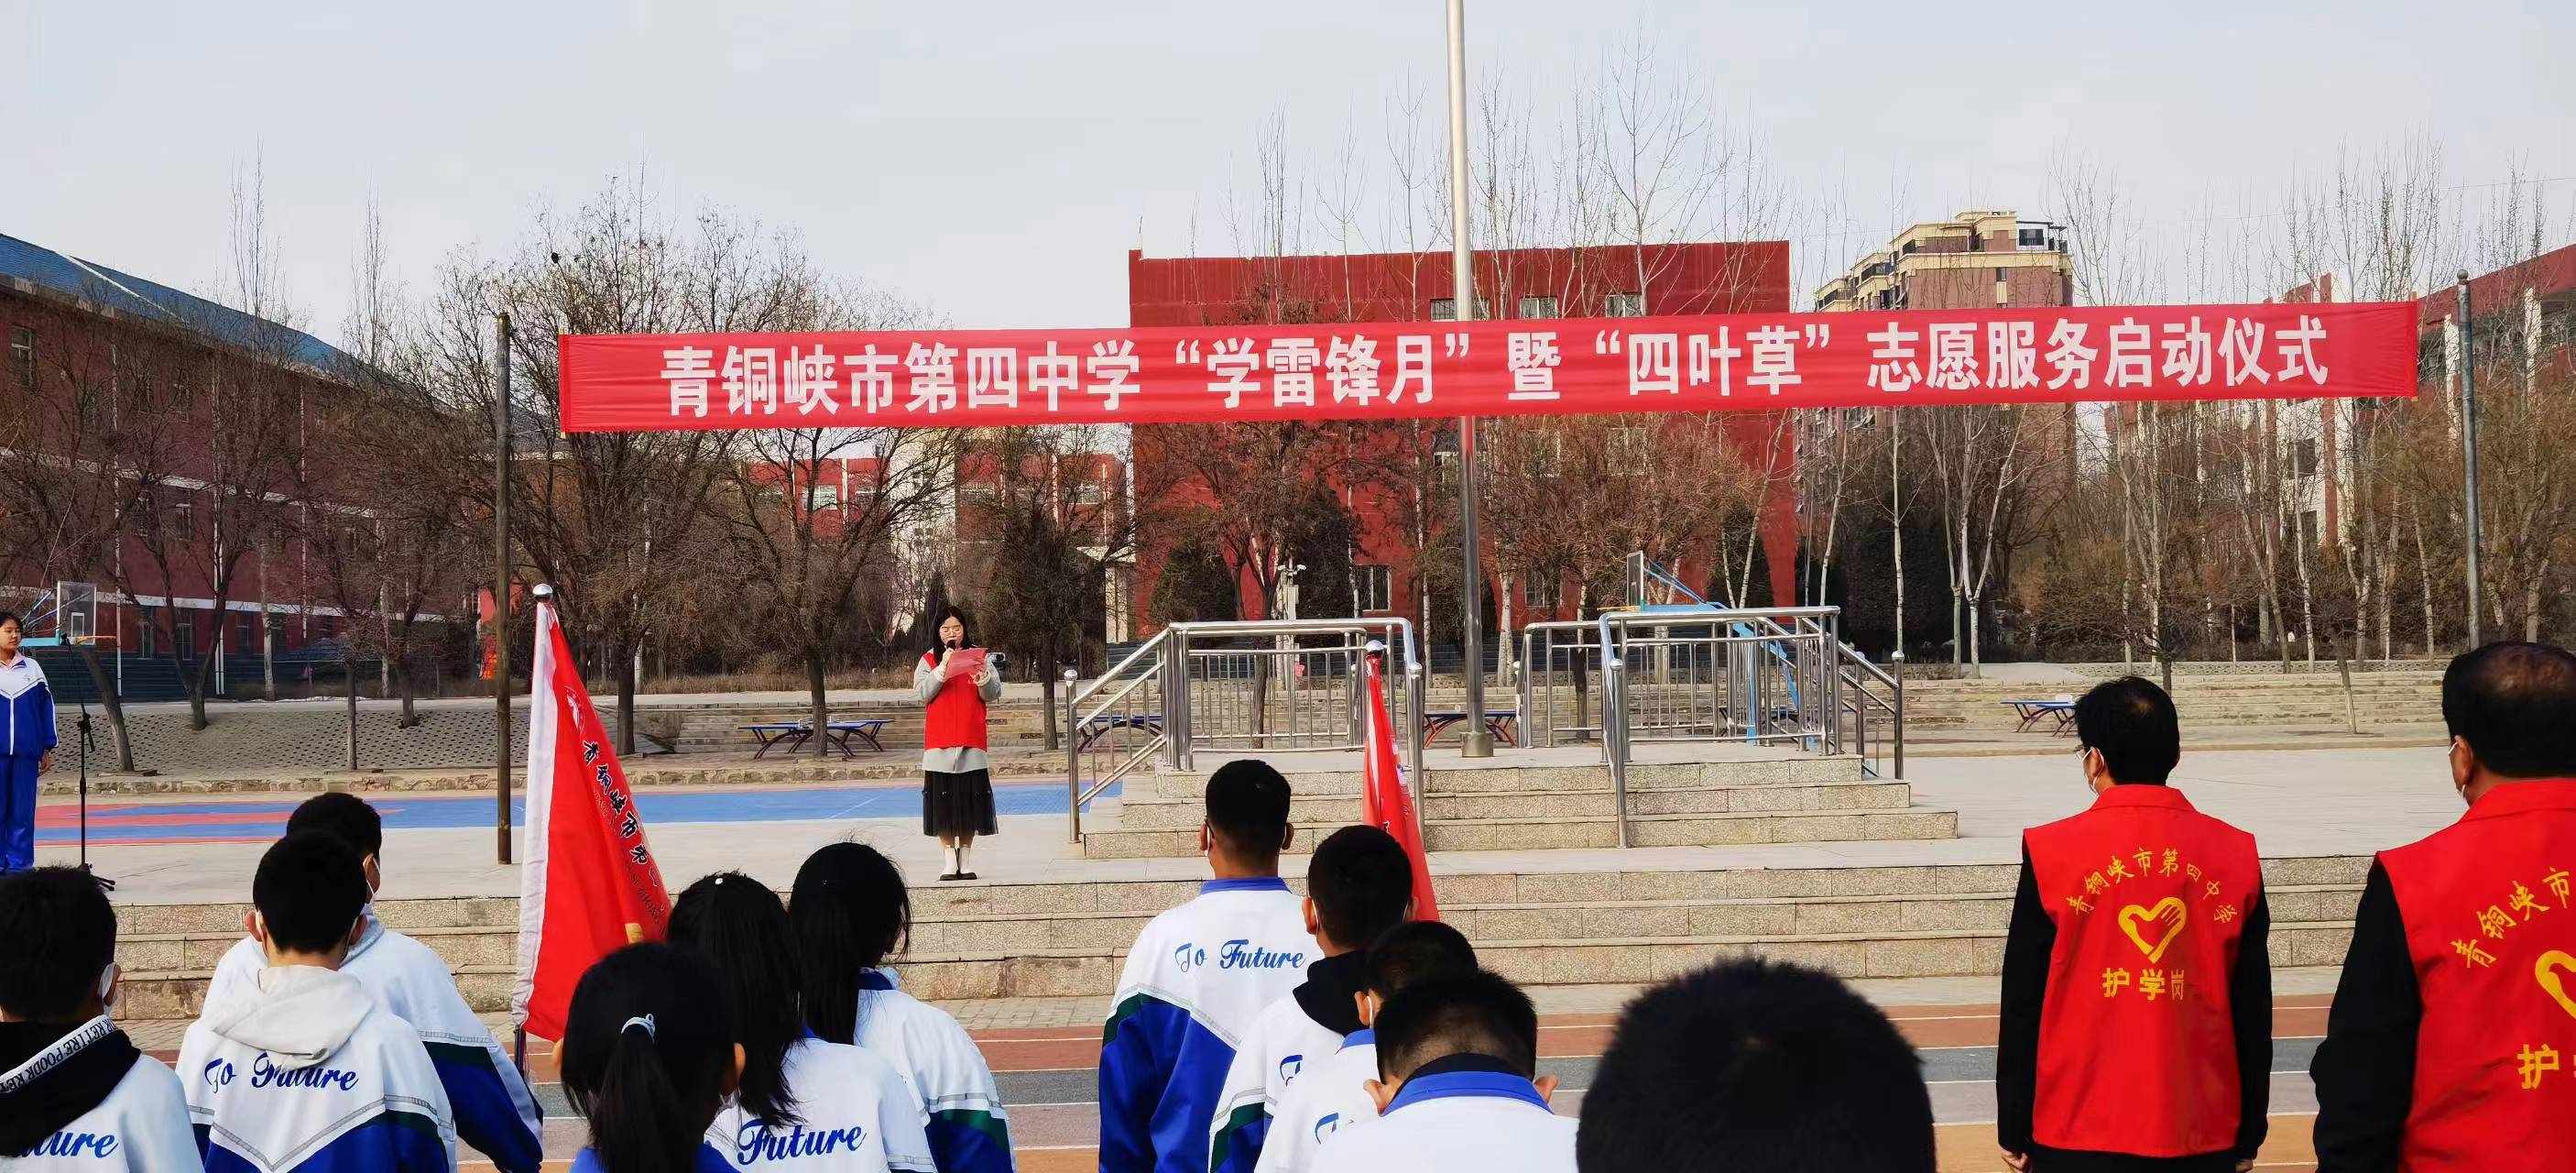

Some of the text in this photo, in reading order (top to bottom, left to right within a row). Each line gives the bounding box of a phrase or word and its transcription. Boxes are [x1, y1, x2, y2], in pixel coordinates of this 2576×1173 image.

[2066, 846, 2238, 924] 青铜峡市第四中学
[1219, 938, 1306, 970] Future
[2101, 967, 2185, 1001] 护学岗
[2516, 1043, 2576, 1090] 护
[737, 1117, 868, 1166] Future
